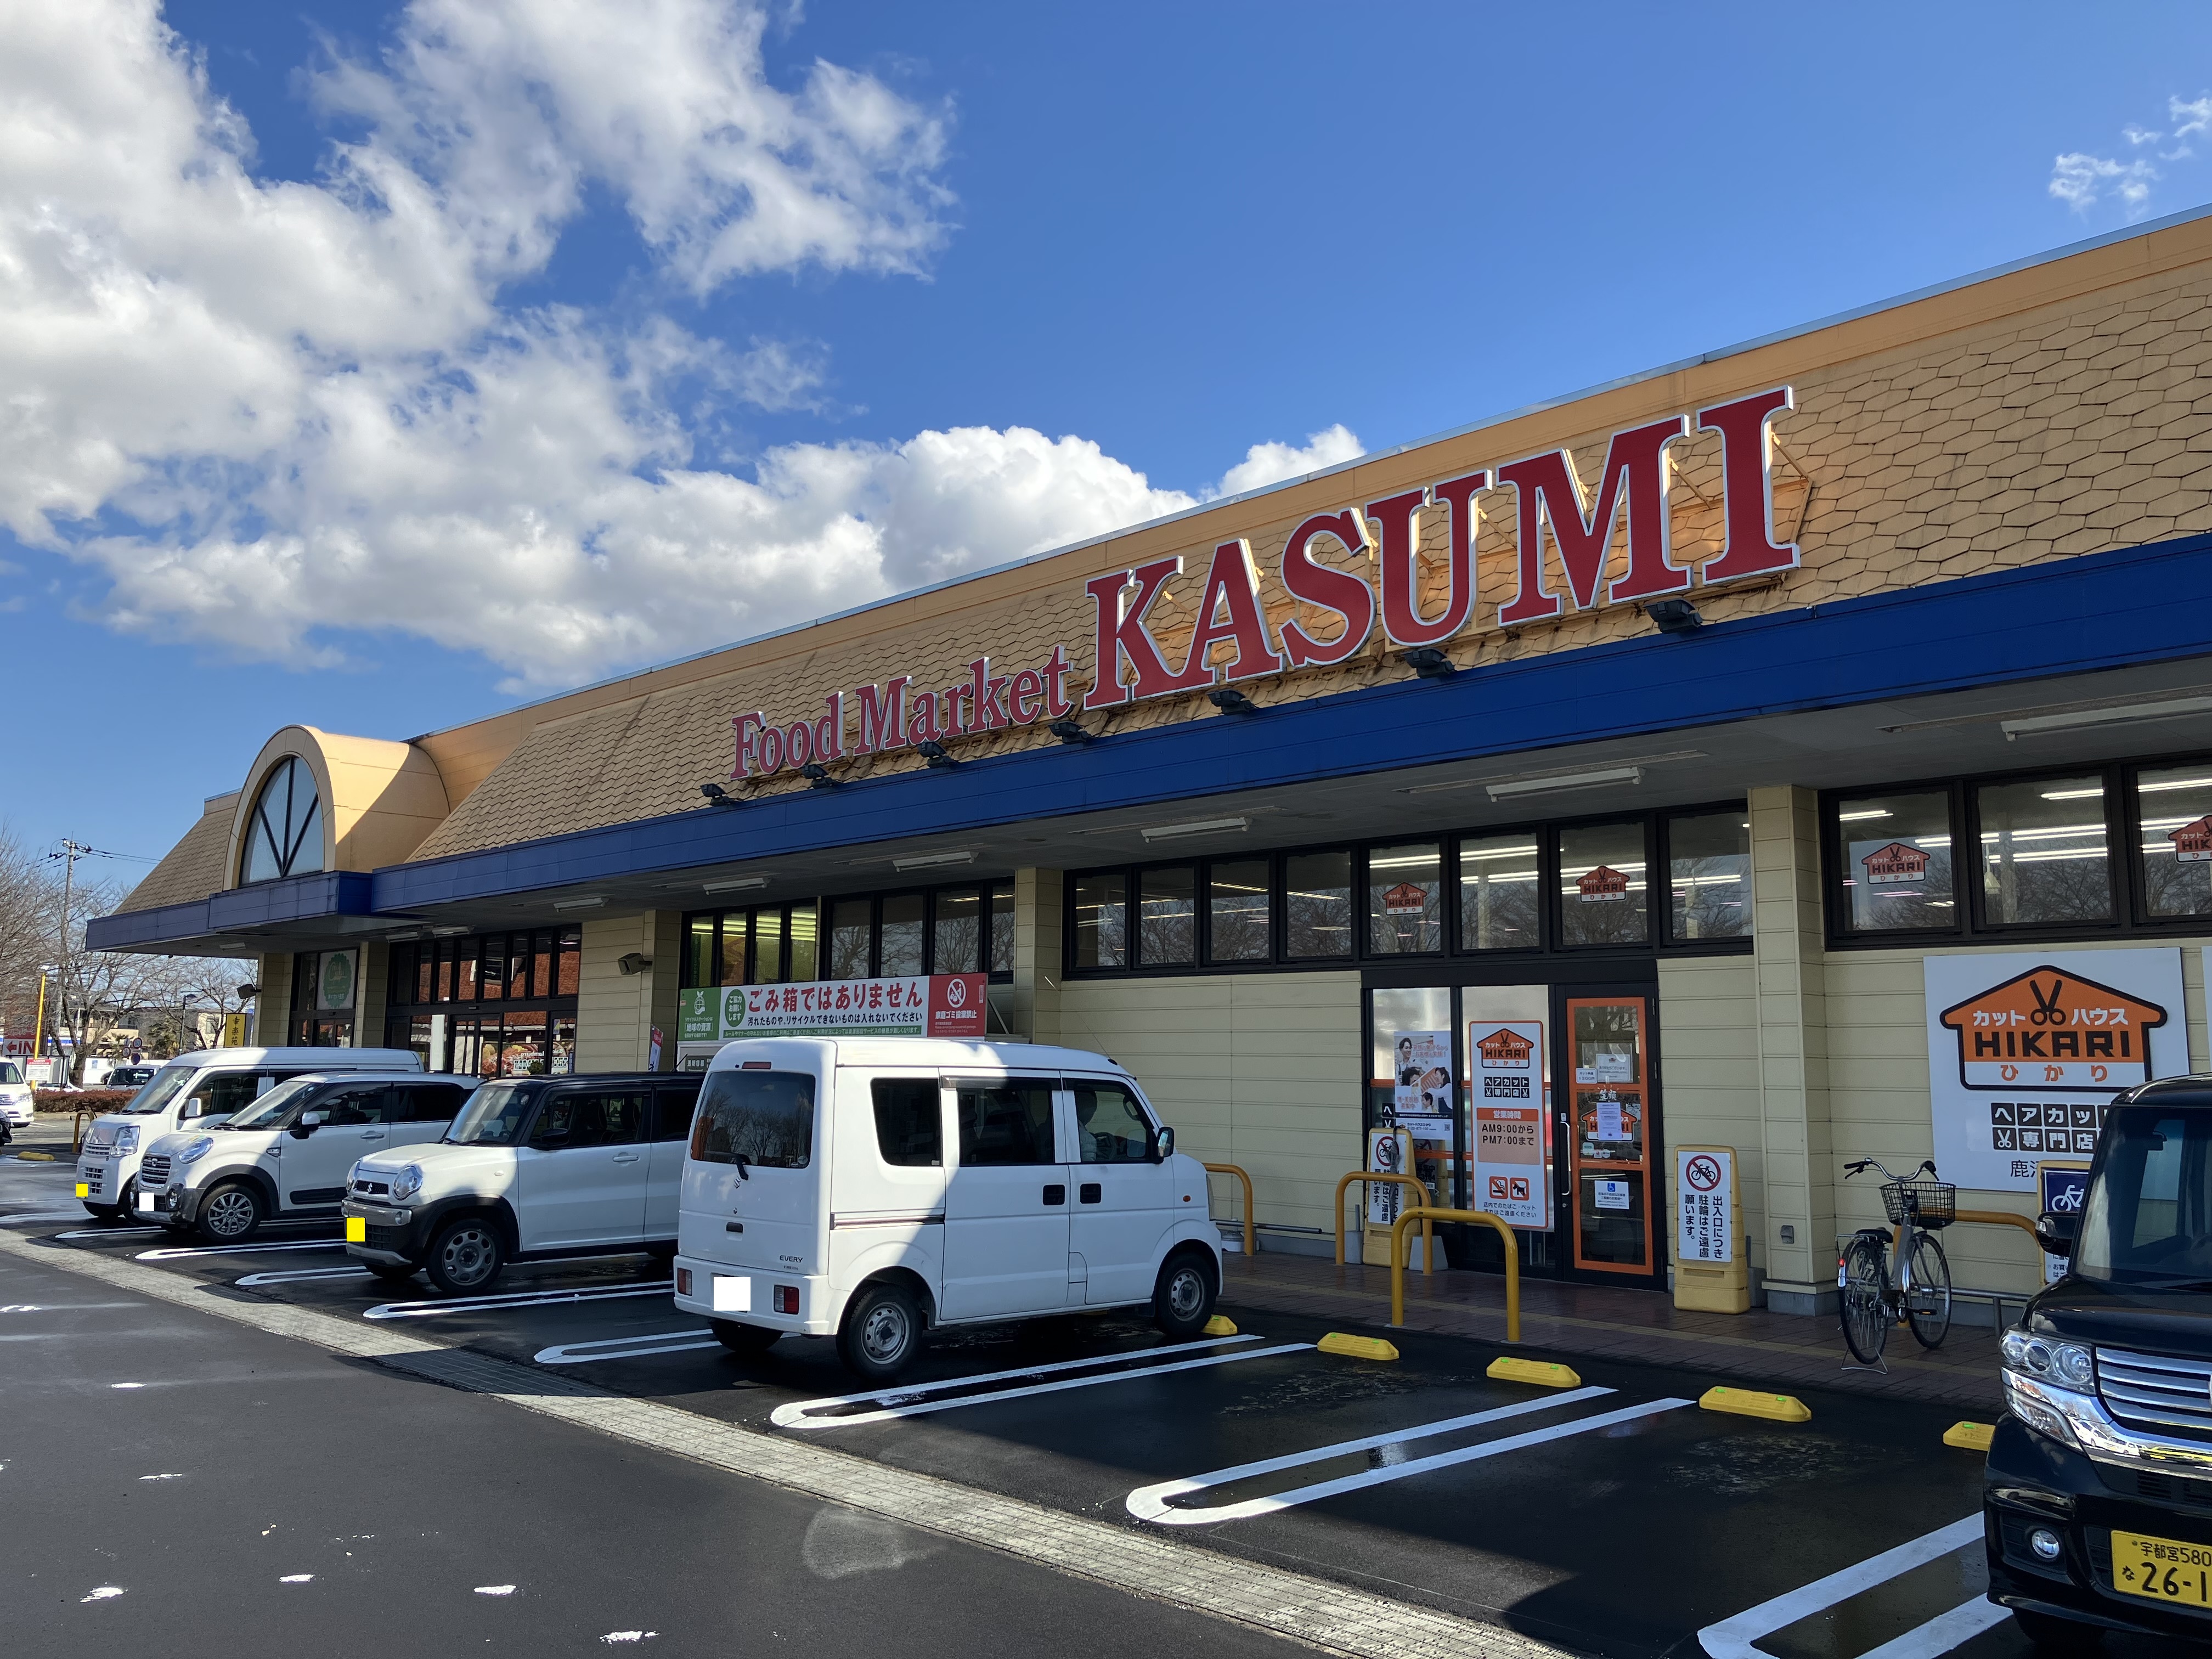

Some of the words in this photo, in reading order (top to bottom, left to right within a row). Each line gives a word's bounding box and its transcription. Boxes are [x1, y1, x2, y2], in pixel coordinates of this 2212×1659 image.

[730, 691, 846, 779] Food
[854, 645, 1074, 756] Market
[1084, 385, 1801, 711] KASUMI
[1872, 862, 1920, 873] HIKARI
[1584, 883, 1622, 893] HIKARI
[1389, 898, 1420, 907] HIKARI
[748, 980, 923, 1012] ごみ箱ではありません
[935, 1010, 977, 1019] 家庭ゴミ投棄禁止
[1973, 1009, 2025, 1026] カット
[2071, 1008, 2128, 1026] ハウス
[231, 1016, 240, 1046] 幸楽苑
[1974, 1030, 2130, 1058] HIKARI
[1486, 1049, 1525, 1058] HIKARI
[2000, 1064, 2108, 1082] ひかり
[1493, 1110, 1521, 1119] 営業時間
[1994, 1107, 2108, 1125] ヘアカッ
[1482, 1124, 1534, 1134] AM9:00から
[1483, 1135, 1534, 1146] PM7:00まで
[2022, 1132, 2094, 1150] 専門店
[1685, 1194, 1695, 1240] 願います。
[1699, 1194, 1709, 1258] 駐輪はご遠慮
[1713, 1195, 1723, 1259] 出入口につき
[779, 1255, 803, 1263] EVERY
[2122, 1565, 2135, 1581] な
